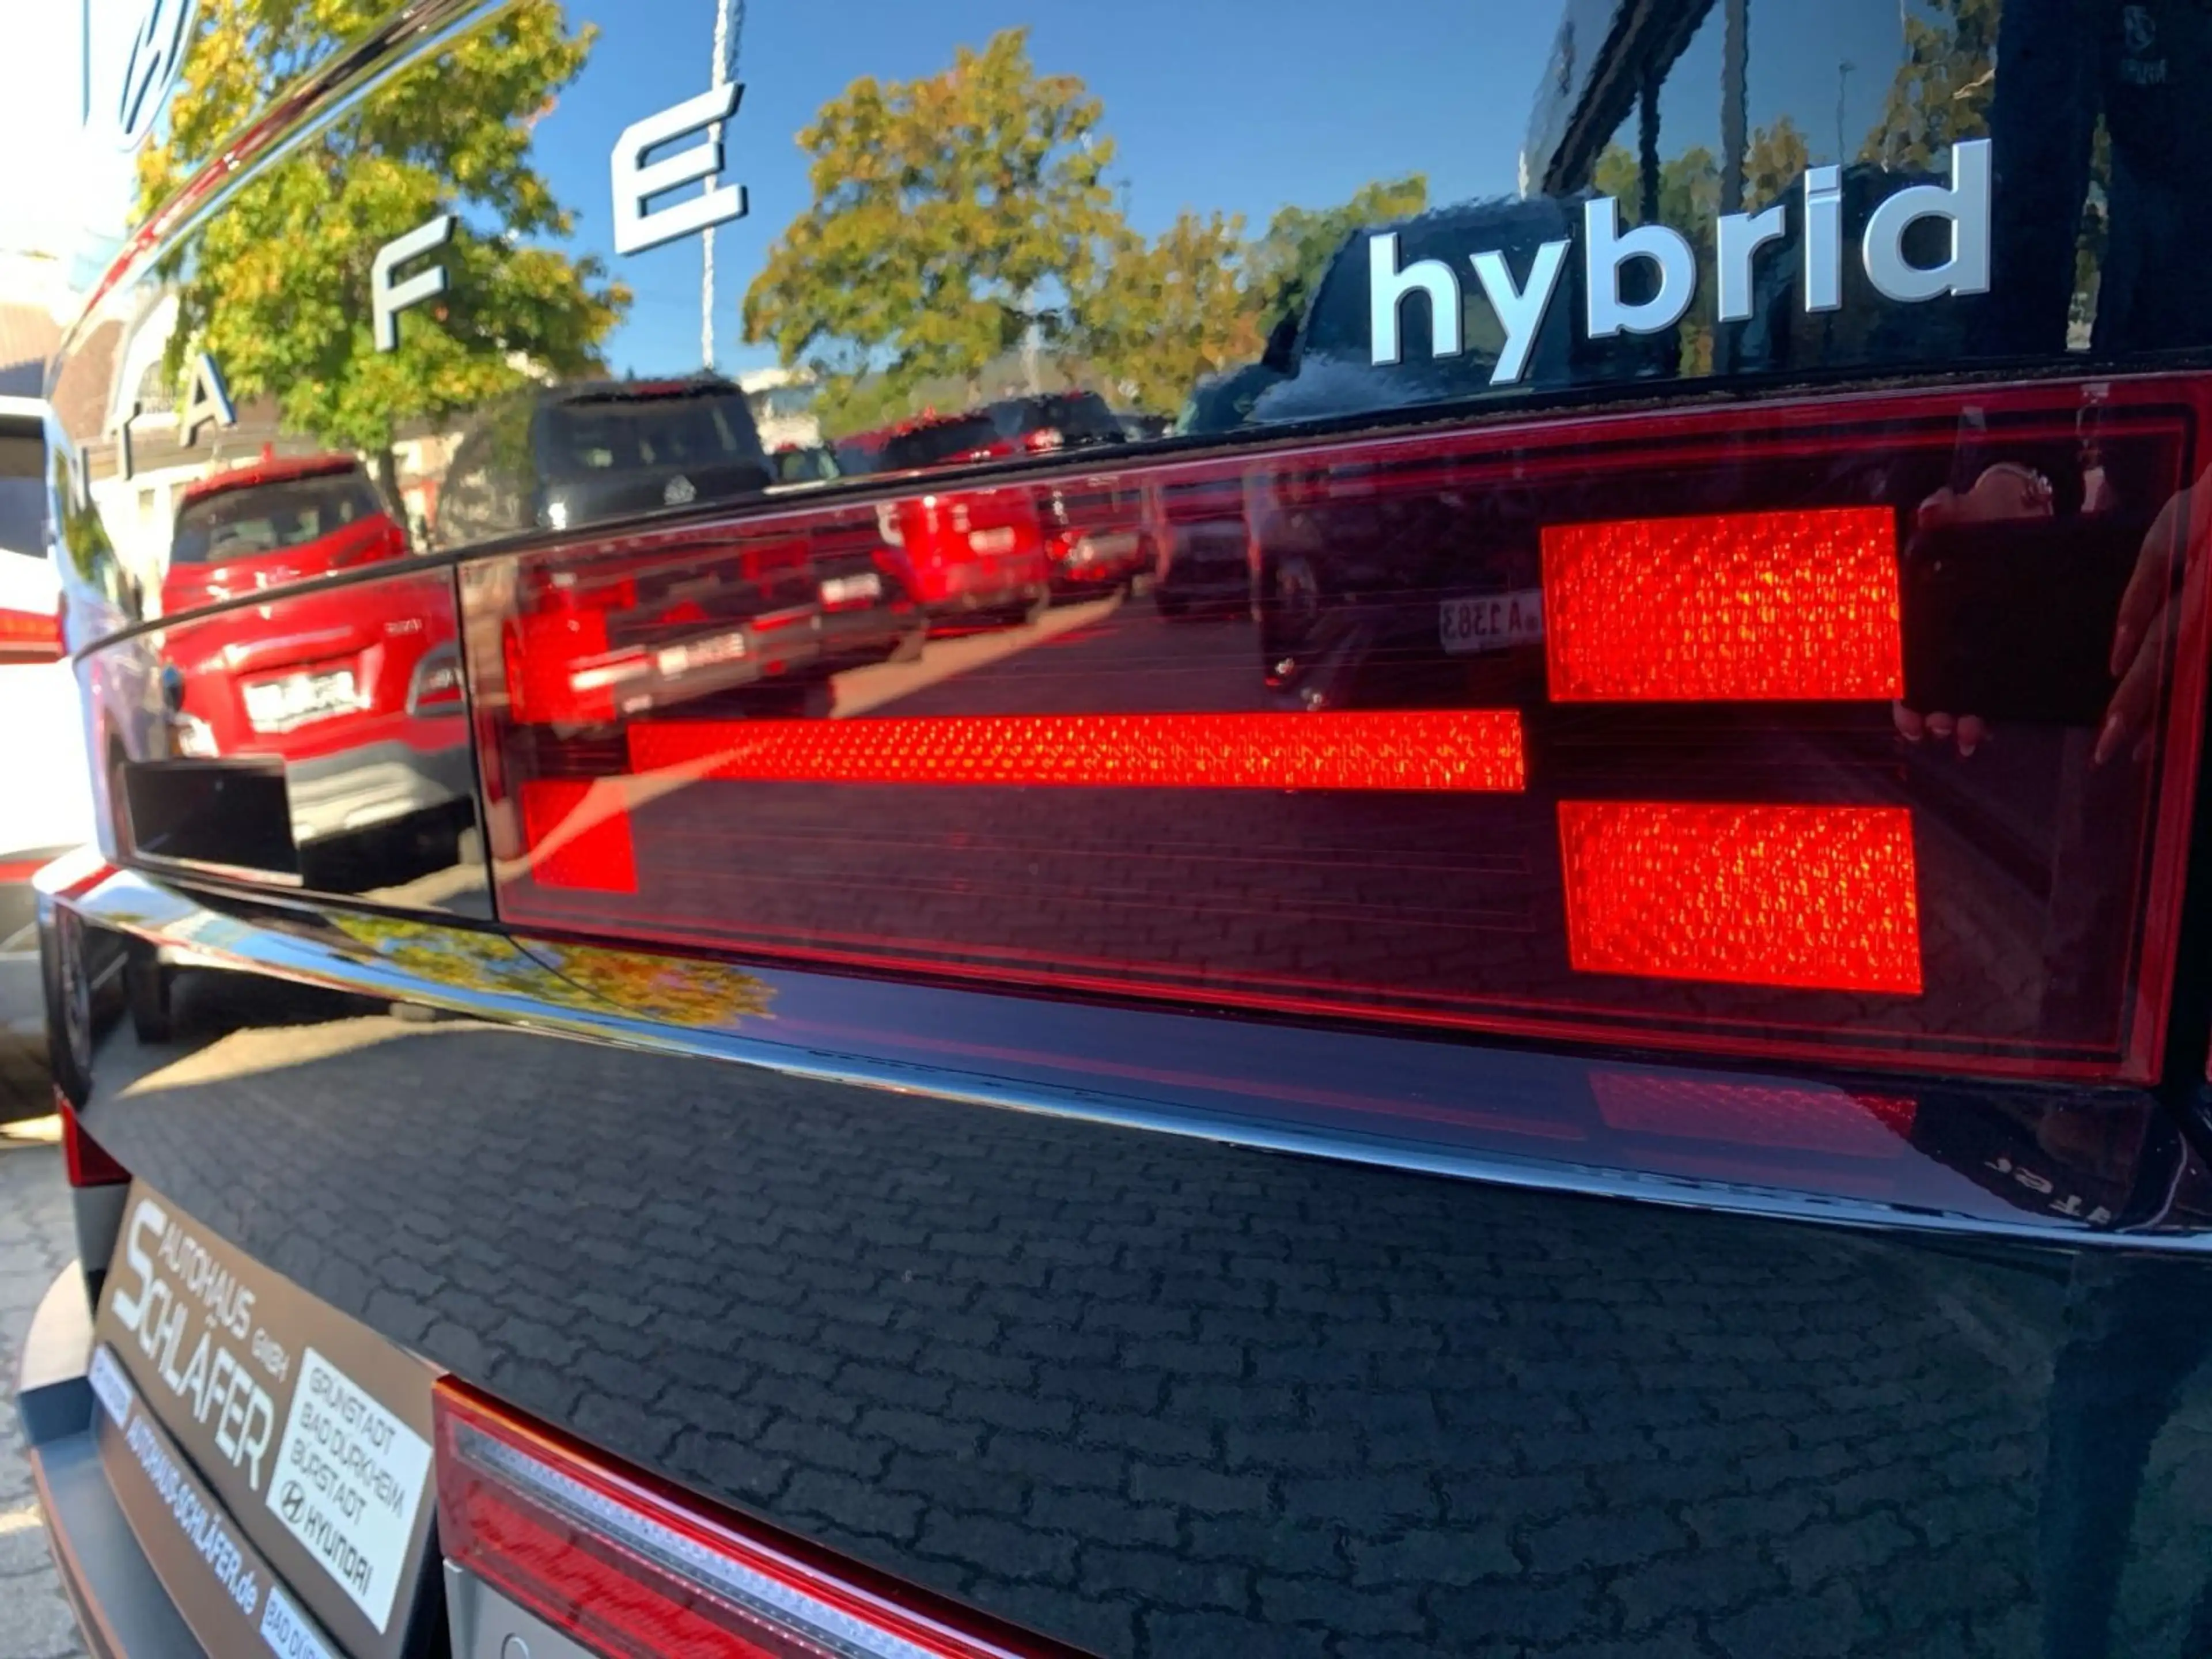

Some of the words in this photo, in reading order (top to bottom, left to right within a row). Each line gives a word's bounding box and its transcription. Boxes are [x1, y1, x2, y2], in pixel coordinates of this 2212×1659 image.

[1369, 138, 1993, 385] hybrid
[158, 1222, 256, 1340] AUTOHAUS
[299, 1400, 332, 1445] BAD
[329, 1428, 406, 1520] DÜRKHEIM
[304, 1504, 374, 1597] HYUNDAI
[264, 1600, 291, 1645] BAD
